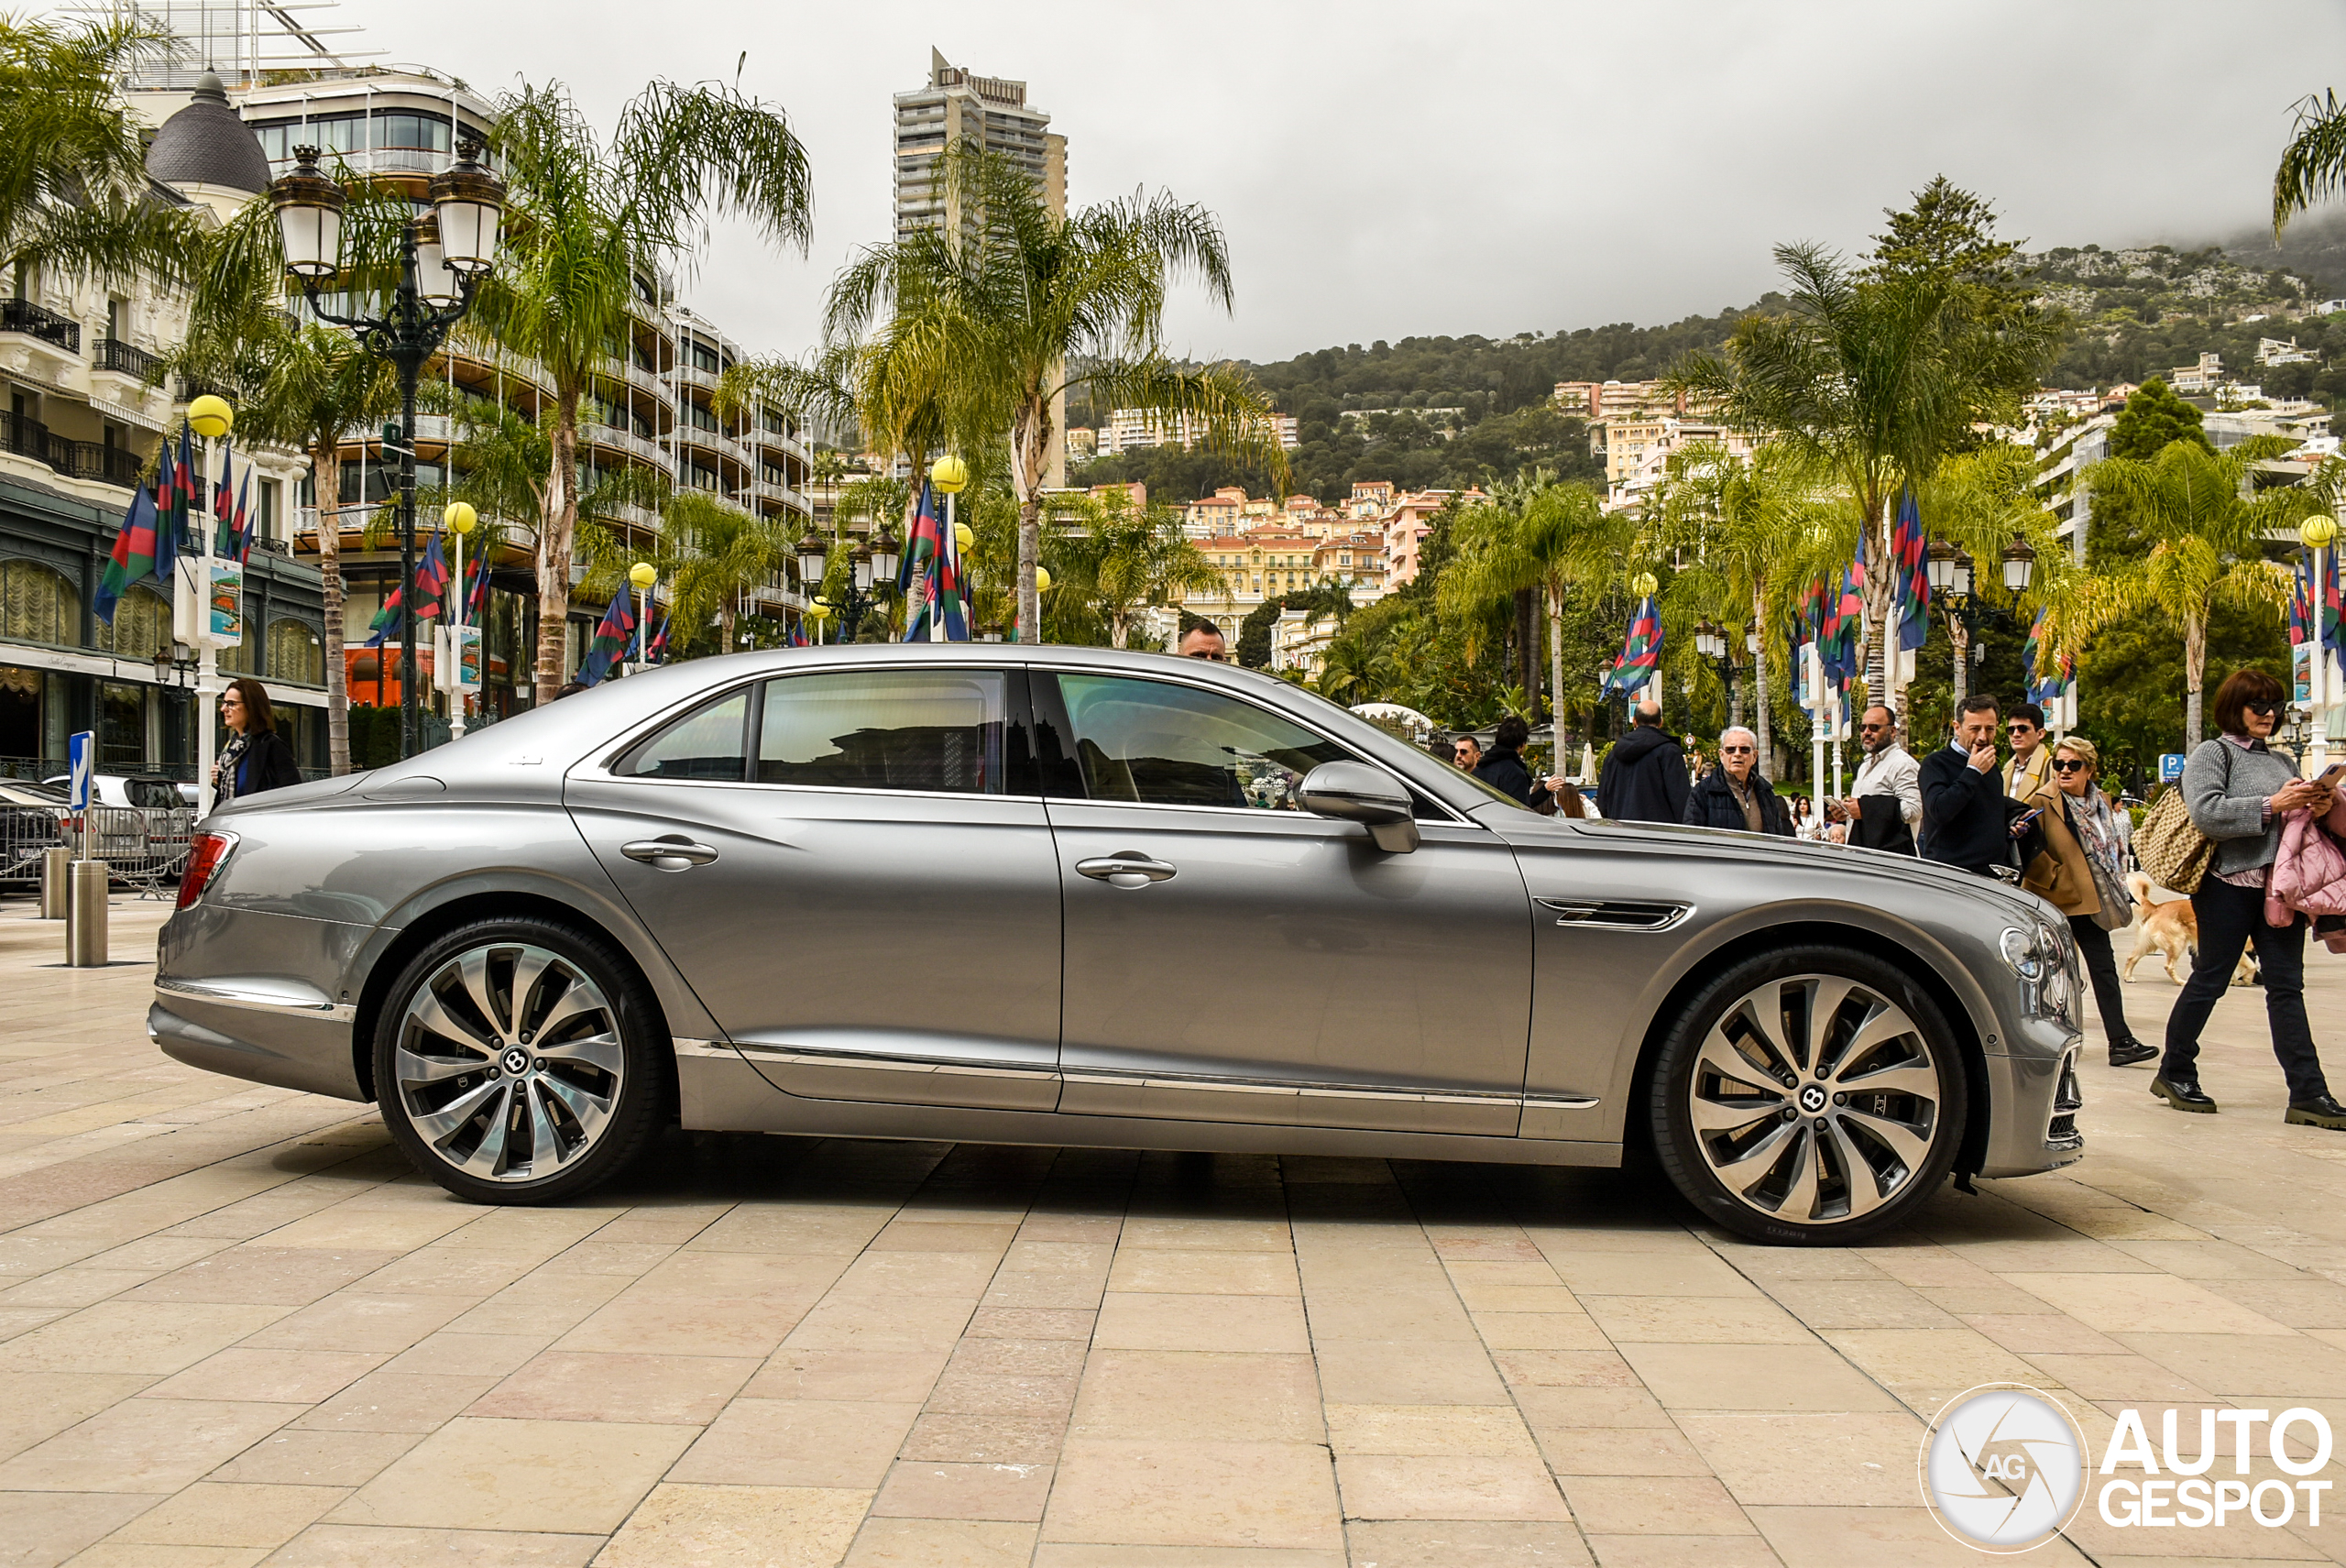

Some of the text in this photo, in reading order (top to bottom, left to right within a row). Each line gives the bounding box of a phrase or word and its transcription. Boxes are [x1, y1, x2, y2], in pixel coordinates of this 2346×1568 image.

[2168, 757, 2177, 770] P
[505, 1050, 526, 1071] B
[1803, 1088, 1825, 1110] B
